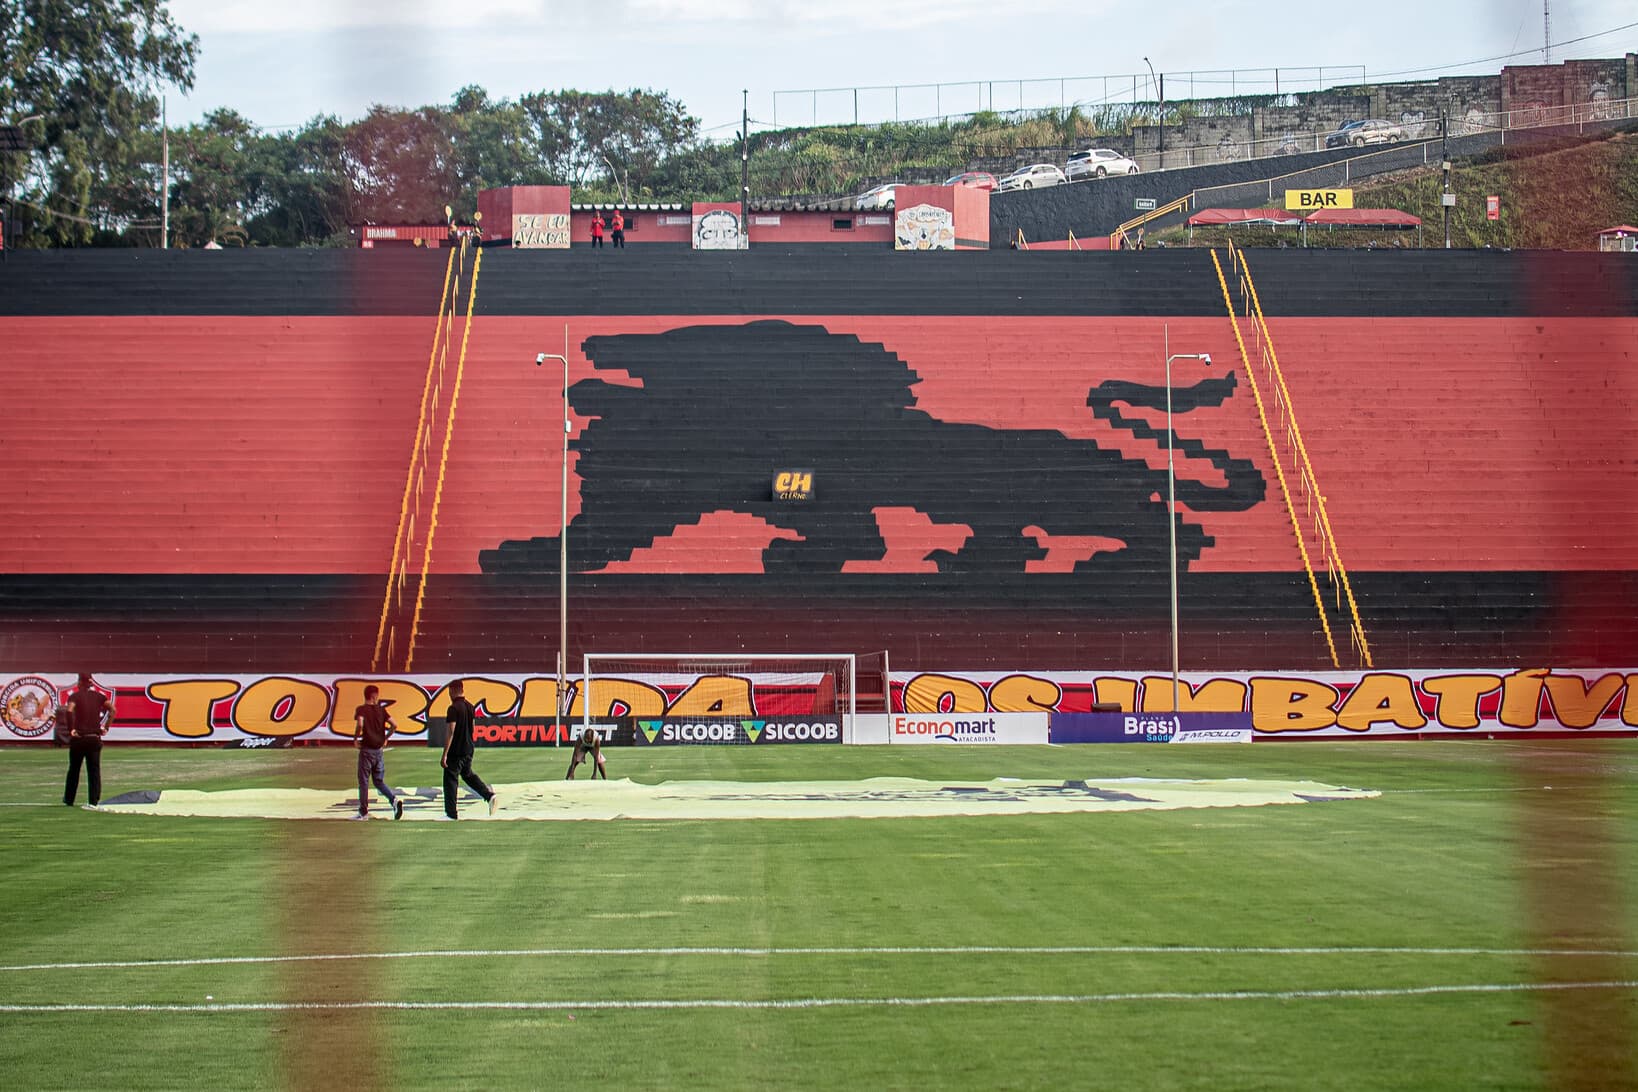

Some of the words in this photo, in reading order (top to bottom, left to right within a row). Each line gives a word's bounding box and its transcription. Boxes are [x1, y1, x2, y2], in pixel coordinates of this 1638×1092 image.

[1300, 193, 1338, 206] BAR
[775, 472, 812, 491] CH
[147, 675, 757, 738] TORCIDA
[903, 674, 1061, 713] OS
[1093, 668, 1638, 733] IMBATÍV
[663, 724, 735, 741] SICOOB
[765, 723, 838, 740] SICOOB
[895, 718, 996, 736] Economart
